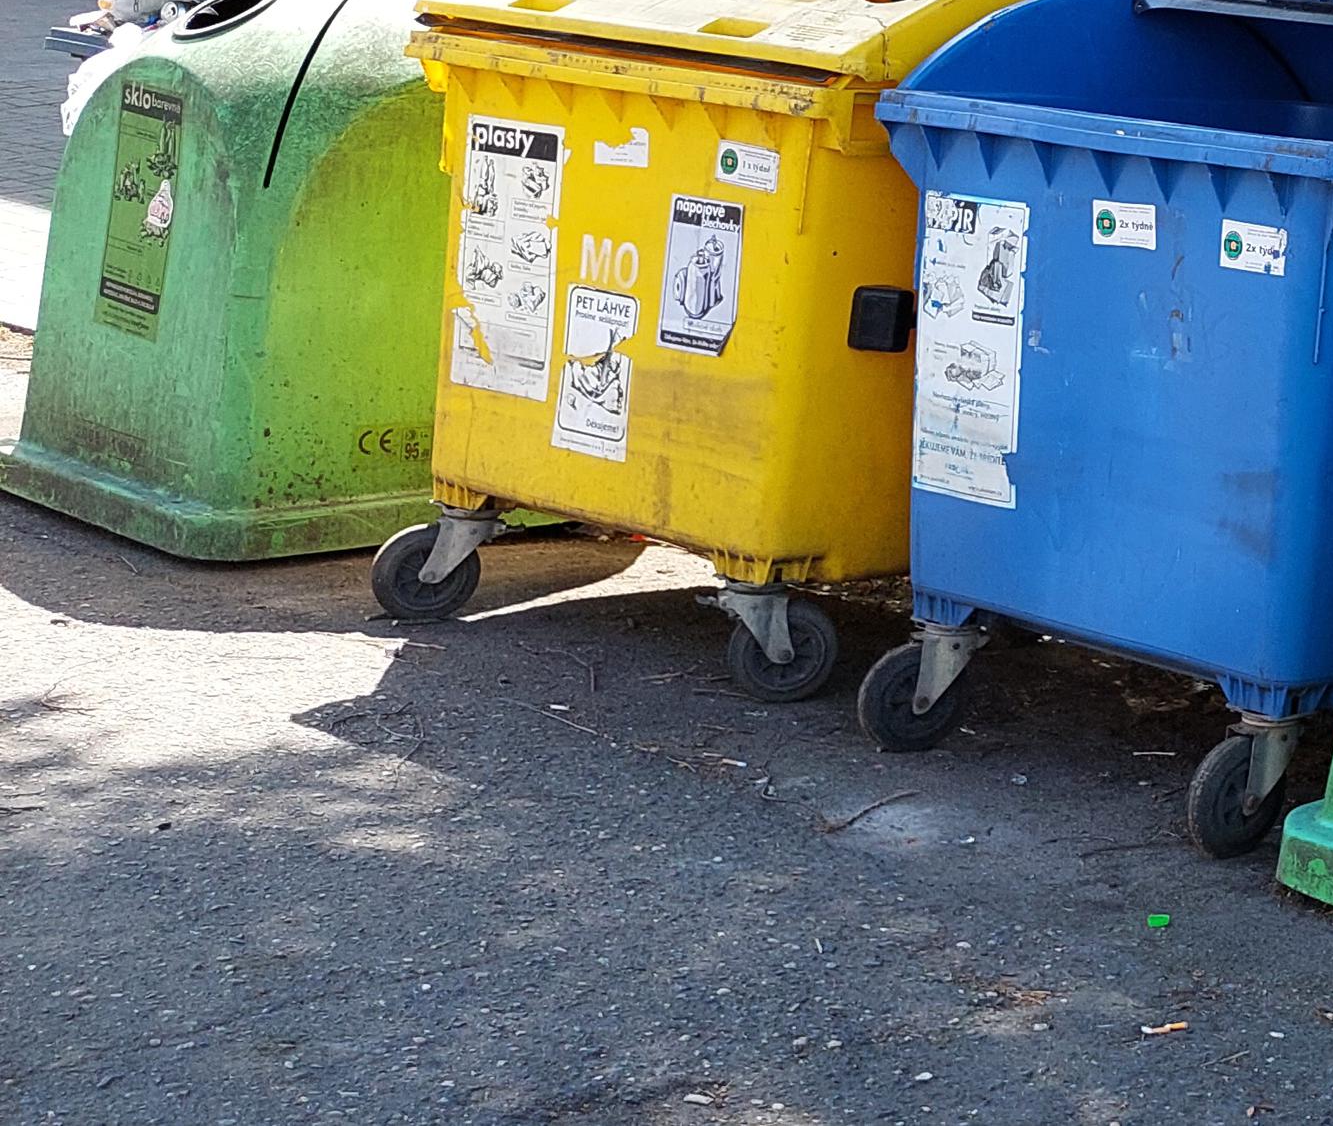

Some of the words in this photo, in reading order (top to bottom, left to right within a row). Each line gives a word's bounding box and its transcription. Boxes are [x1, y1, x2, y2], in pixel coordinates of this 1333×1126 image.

[124, 81, 151, 110] sklo
[475, 123, 535, 158] plasty
[702, 216, 741, 234] plechovky
[1119, 220, 1129, 229] 2x
[1132, 220, 1154, 232] týdně
[1246, 243, 1256, 253] 2x
[580, 234, 640, 290] MO
[576, 295, 595, 310] PET
[597, 298, 631, 319] LÁHVE
